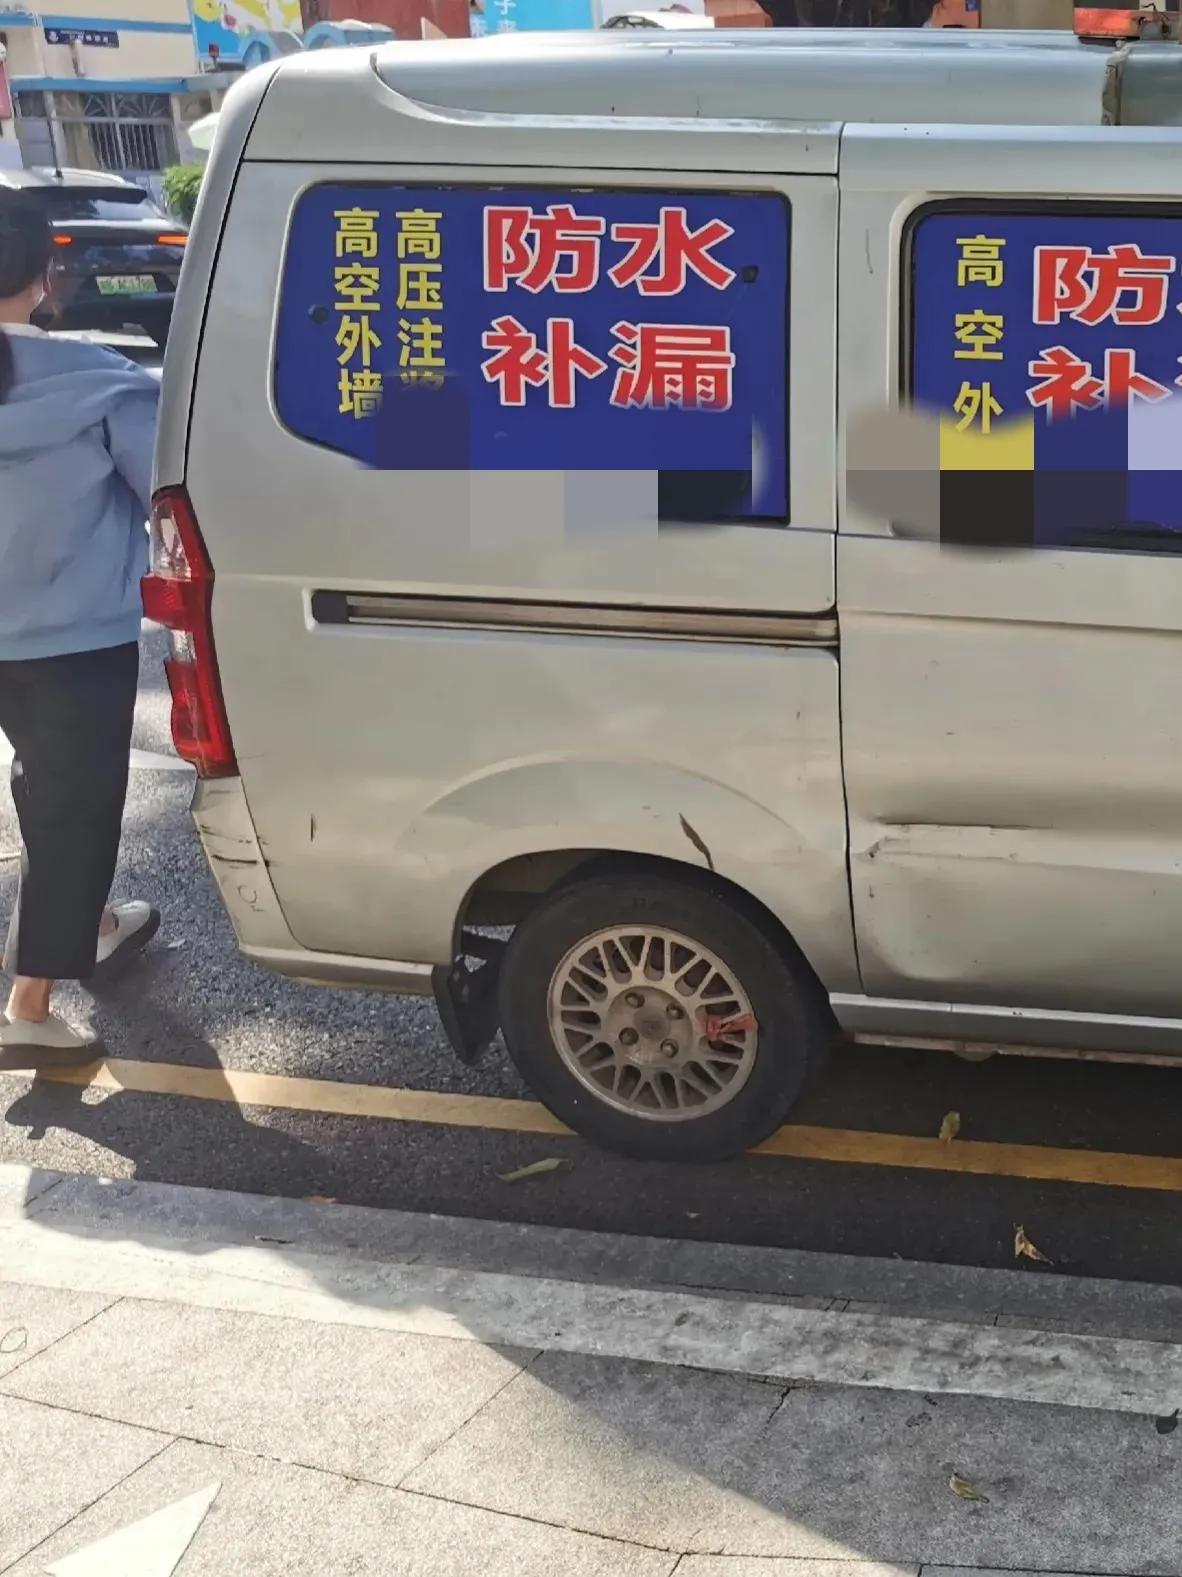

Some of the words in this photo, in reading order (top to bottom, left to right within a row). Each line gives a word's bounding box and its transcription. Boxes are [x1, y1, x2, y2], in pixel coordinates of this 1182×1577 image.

[333, 207, 383, 420] 高空外墙
[483, 204, 735, 296] 防水
[481, 315, 736, 412] 补漏
[953, 235, 1005, 435] 高空外
